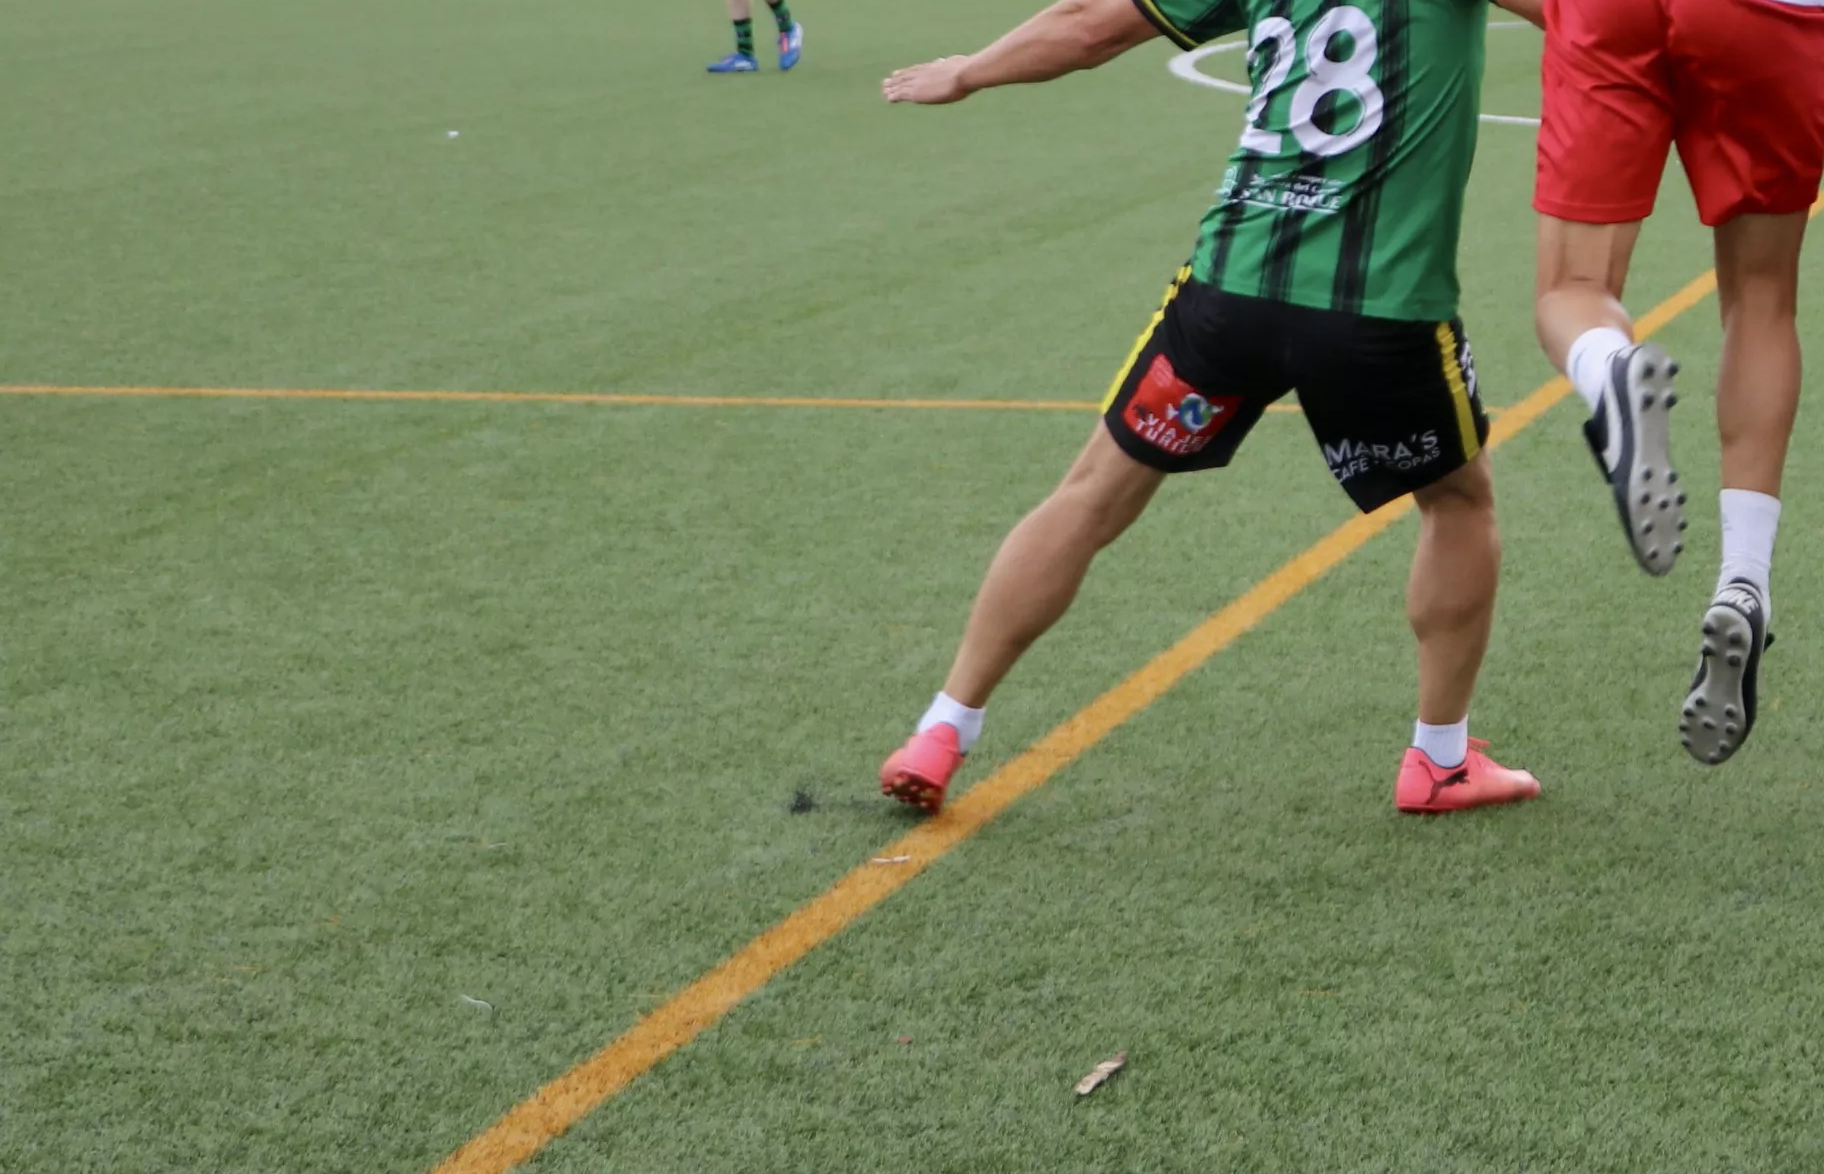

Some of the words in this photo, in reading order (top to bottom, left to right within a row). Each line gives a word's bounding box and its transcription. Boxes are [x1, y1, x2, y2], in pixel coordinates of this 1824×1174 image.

[1240, 5, 1384, 157] 28
[1323, 428, 1439, 467] MARA'S
[1385, 446, 1442, 471] COPAS
